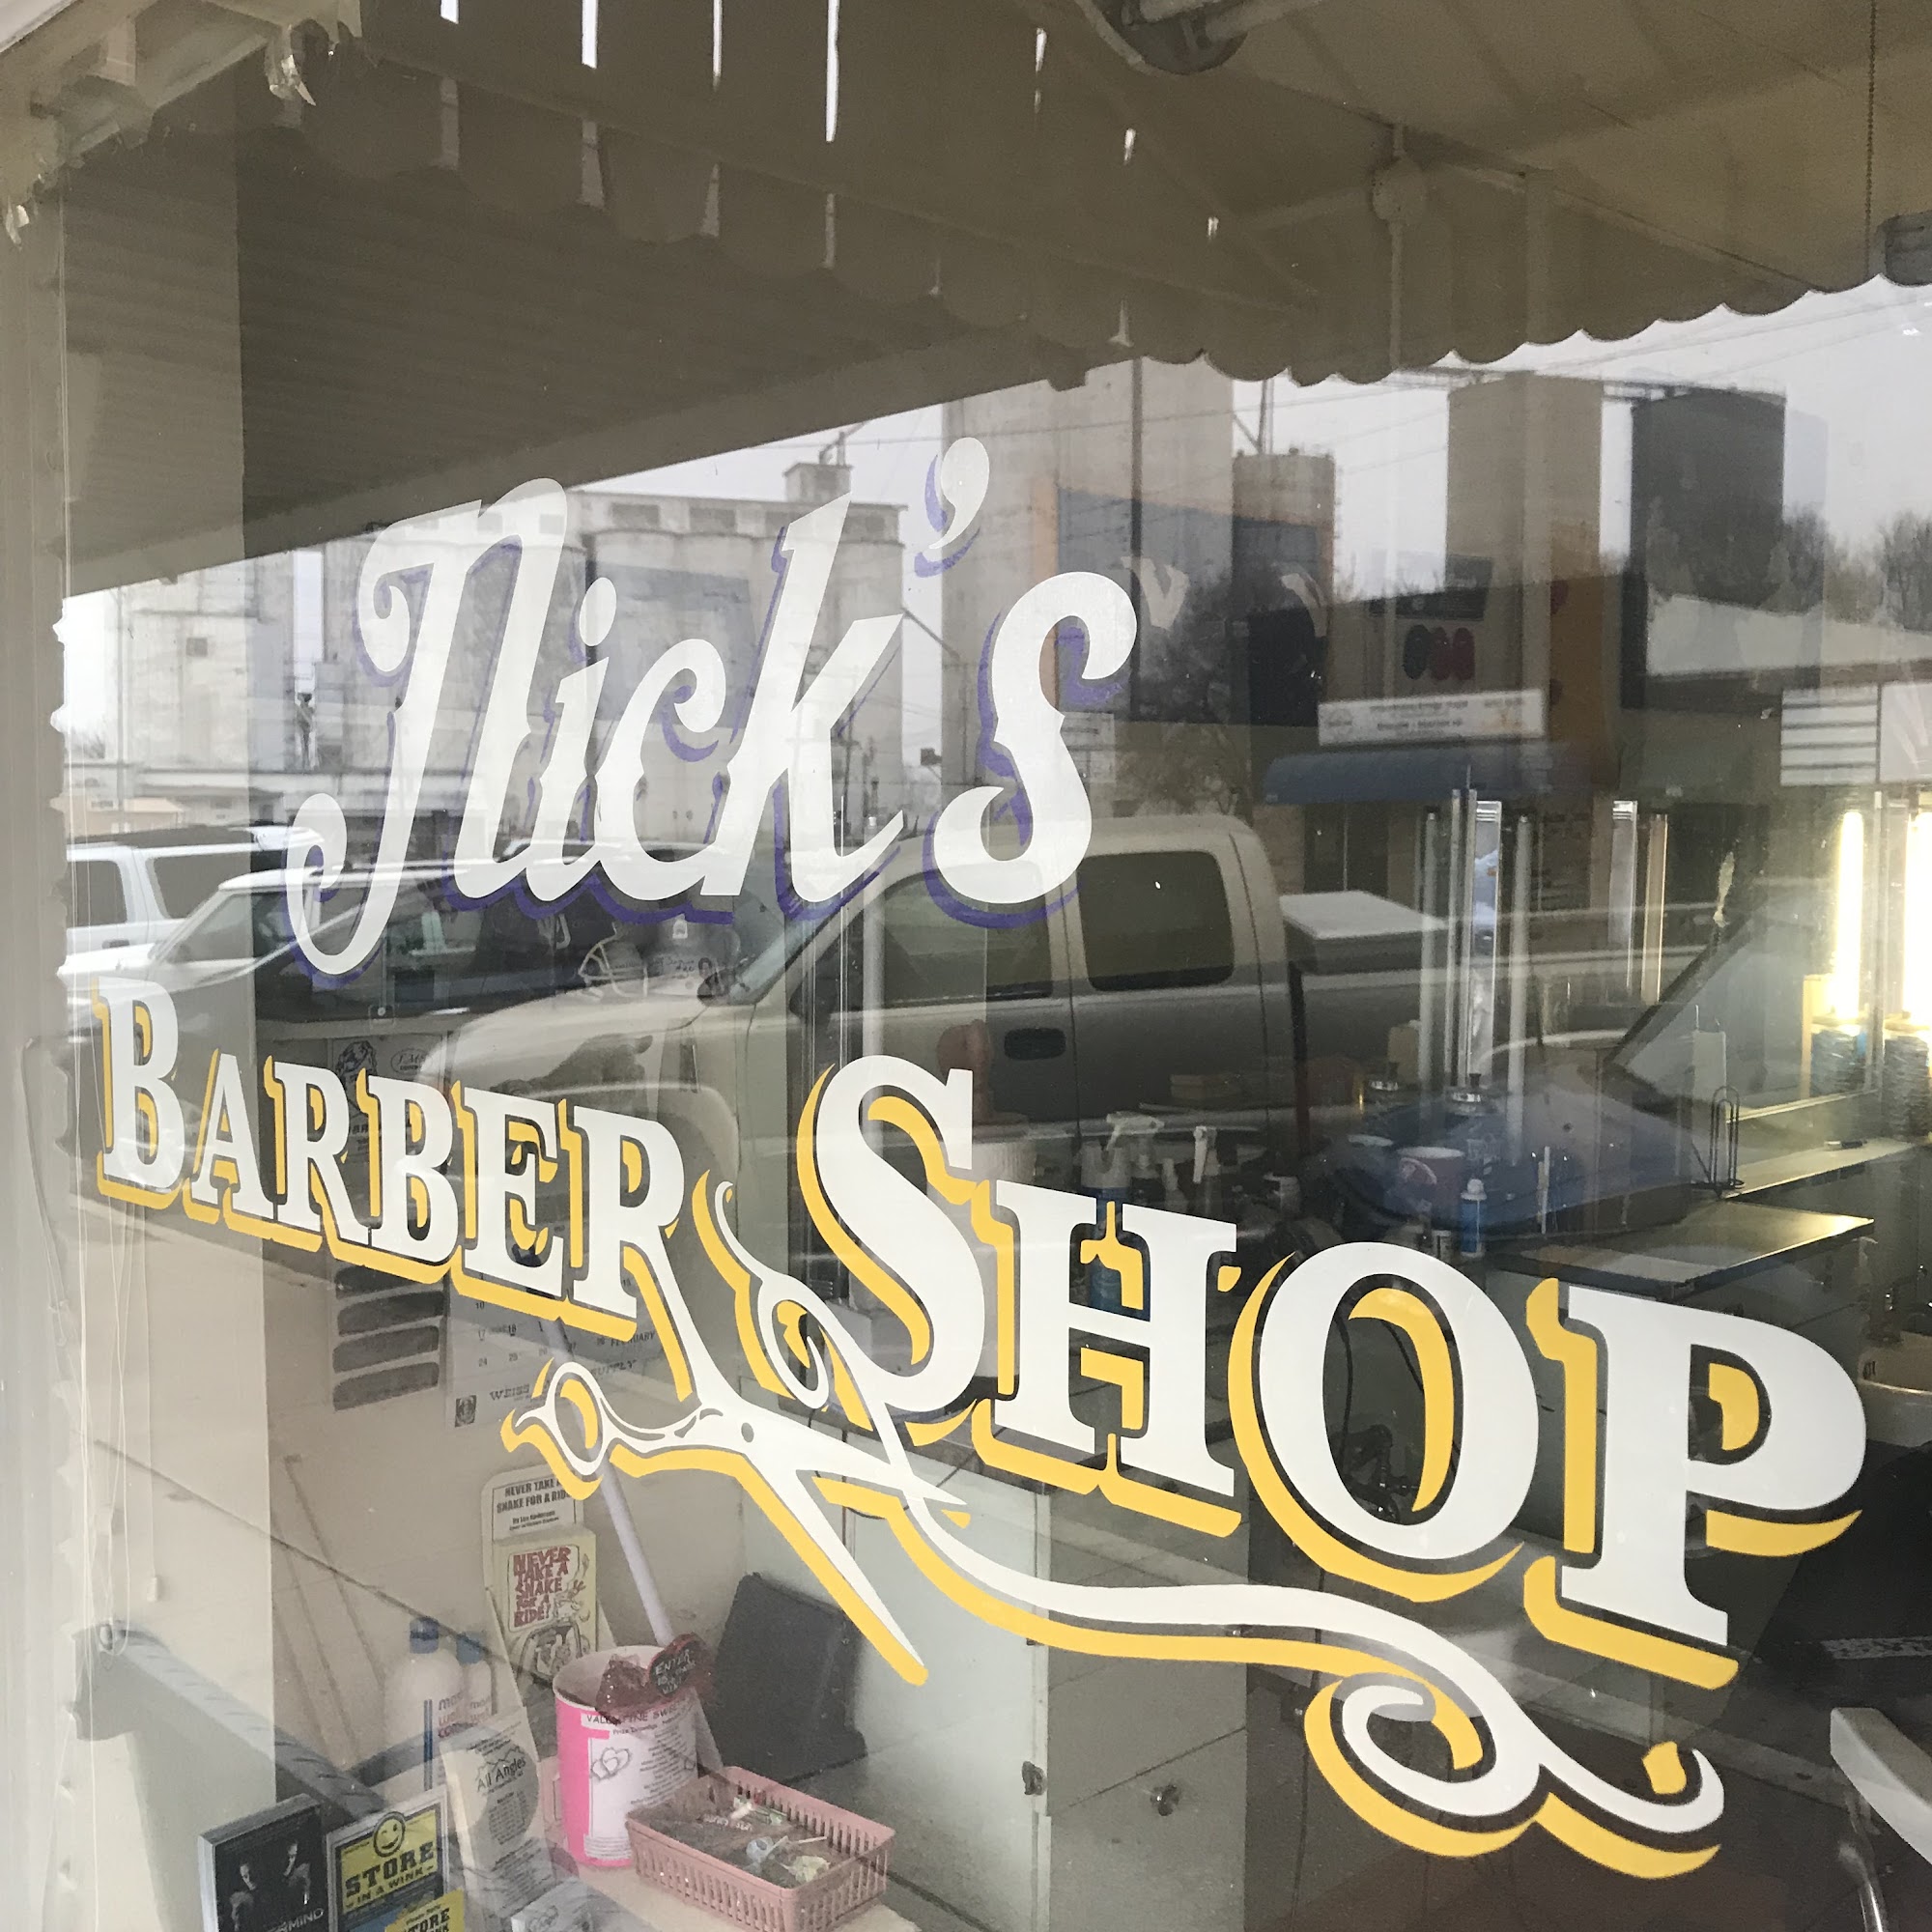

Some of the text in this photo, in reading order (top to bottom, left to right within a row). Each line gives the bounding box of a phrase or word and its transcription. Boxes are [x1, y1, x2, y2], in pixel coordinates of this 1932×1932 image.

[286, 437, 1138, 978] Nick's
[95, 974, 1867, 1650] BARBER SHOP
[610, 1329, 657, 1347] FEUARY
[489, 1383, 530, 1401] WEISS
[504, 1482, 532, 1497] NEVER
[533, 1478, 554, 1492] TAKE
[497, 1497, 525, 1514] SNAKE
[526, 1493, 543, 1507] FOR
[544, 1492, 551, 1503] A
[513, 1546, 572, 1577] NEVER
[518, 1561, 569, 1585] TAKE A
[513, 1603, 552, 1628] RIDE!
[586, 1712, 648, 1726] VALTINE
[477, 1772, 492, 1793] All
[495, 1757, 526, 1782] Angles
[345, 1840, 435, 1898] STORE
[356, 1866, 424, 1903] IN A WINK
[404, 1907, 450, 1932] TORE
